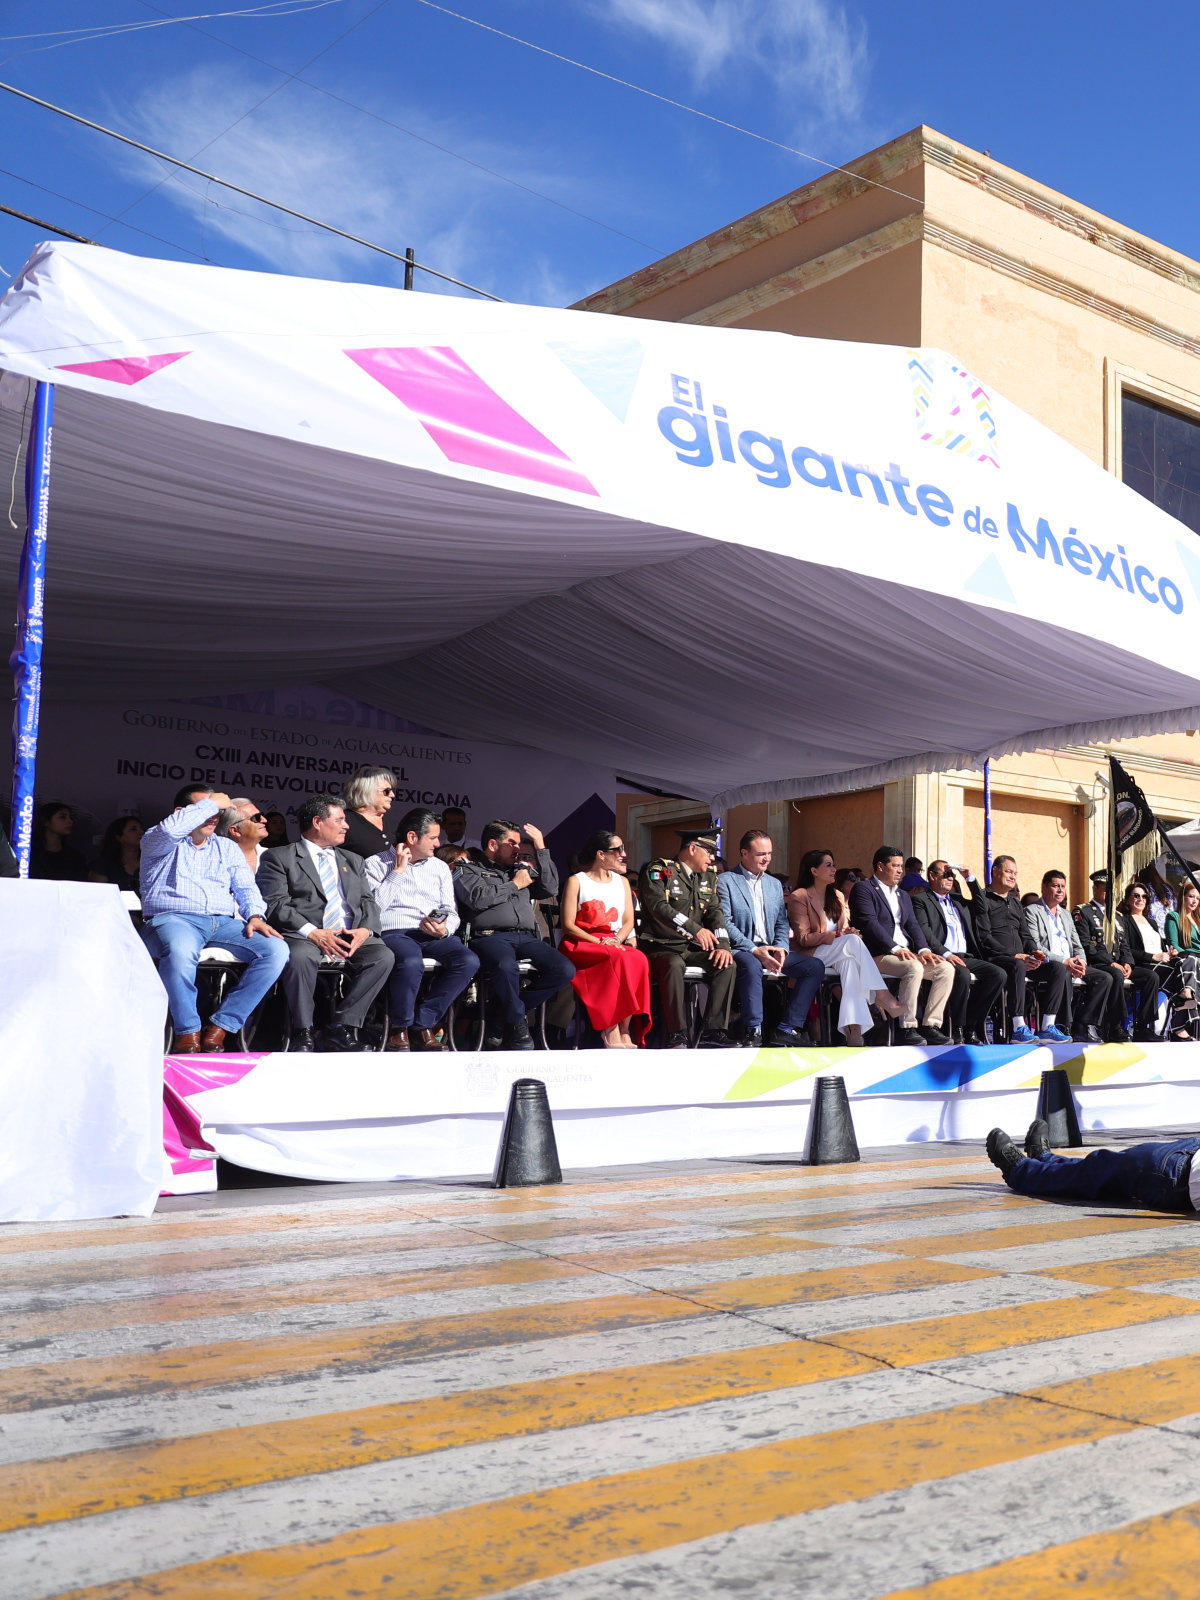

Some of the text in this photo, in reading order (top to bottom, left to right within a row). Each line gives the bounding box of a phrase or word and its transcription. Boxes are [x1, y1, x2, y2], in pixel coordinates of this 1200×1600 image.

[670, 372, 704, 411] El
[657, 404, 1184, 615] gigante de México
[33, 577, 43, 617] gigante
[123, 709, 230, 736] GOBIERNO
[233, 728, 247, 736] DEL
[250, 727, 319, 747] ESTADO
[333, 737, 472, 764] AGUASCALIENTES
[117, 759, 185, 780] INICIO
[190, 767, 216, 784] DE
[221, 770, 246, 787] LA
[393, 788, 472, 809] EXICANA
[195, 744, 409, 782] CXIII ANIVERSARI EL
[19, 795, 34, 848] México
